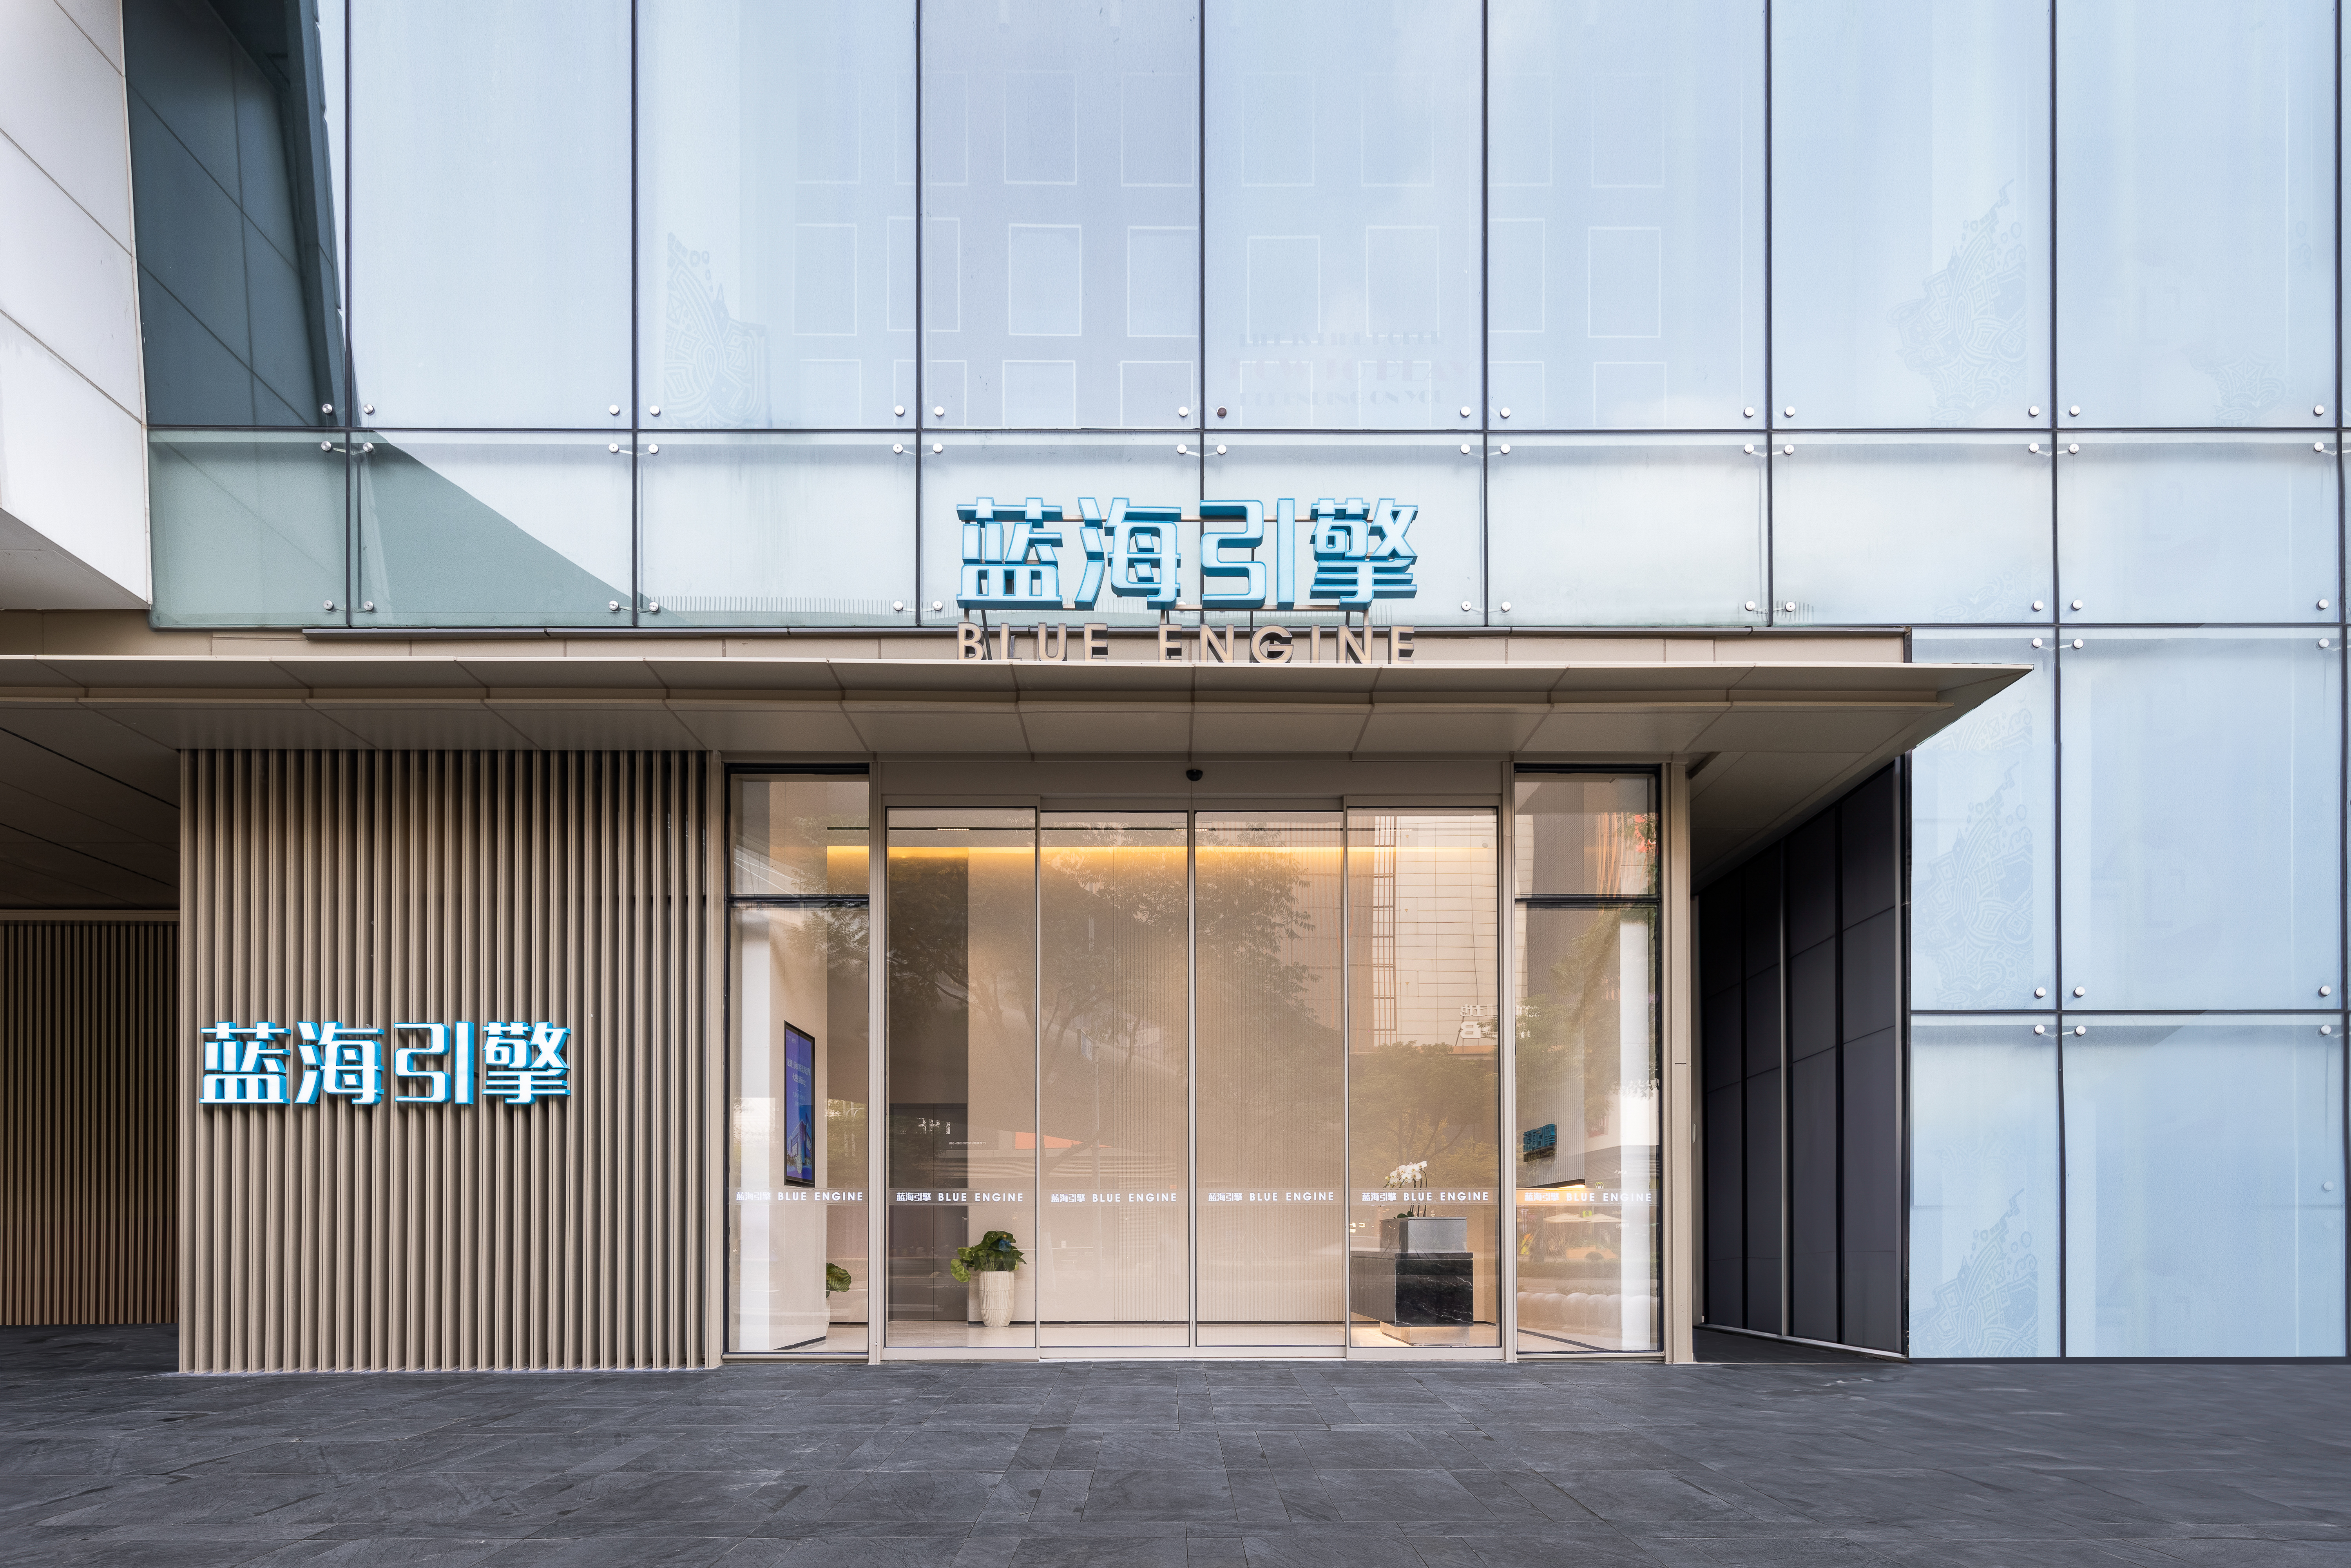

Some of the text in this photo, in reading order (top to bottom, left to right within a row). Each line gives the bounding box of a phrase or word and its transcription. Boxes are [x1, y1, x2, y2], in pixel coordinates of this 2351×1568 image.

[1369, 389, 1399, 405] ON
[1404, 389, 1448, 405] YOU
[956, 496, 1418, 611] 蓝海引擎
[956, 621, 1416, 664] BLUE ENGINE
[199, 1021, 571, 1105] 蓝海引擎
[735, 1192, 863, 1202] 蓝海引擎 BLUE ENGINE
[896, 1192, 1023, 1202] 蓝海引擎 BLUE ENGINE
[1051, 1193, 1177, 1202] 蓝海引擎 BLUE ENGINE
[1208, 1192, 1334, 1202] 蓝海引擎 BLUE ENGINE
[1362, 1192, 1489, 1201] 蓝海引擎 BLUE ENGINE
[1524, 1192, 1652, 1202] 蓝海引擎 BLUE ENGINE
